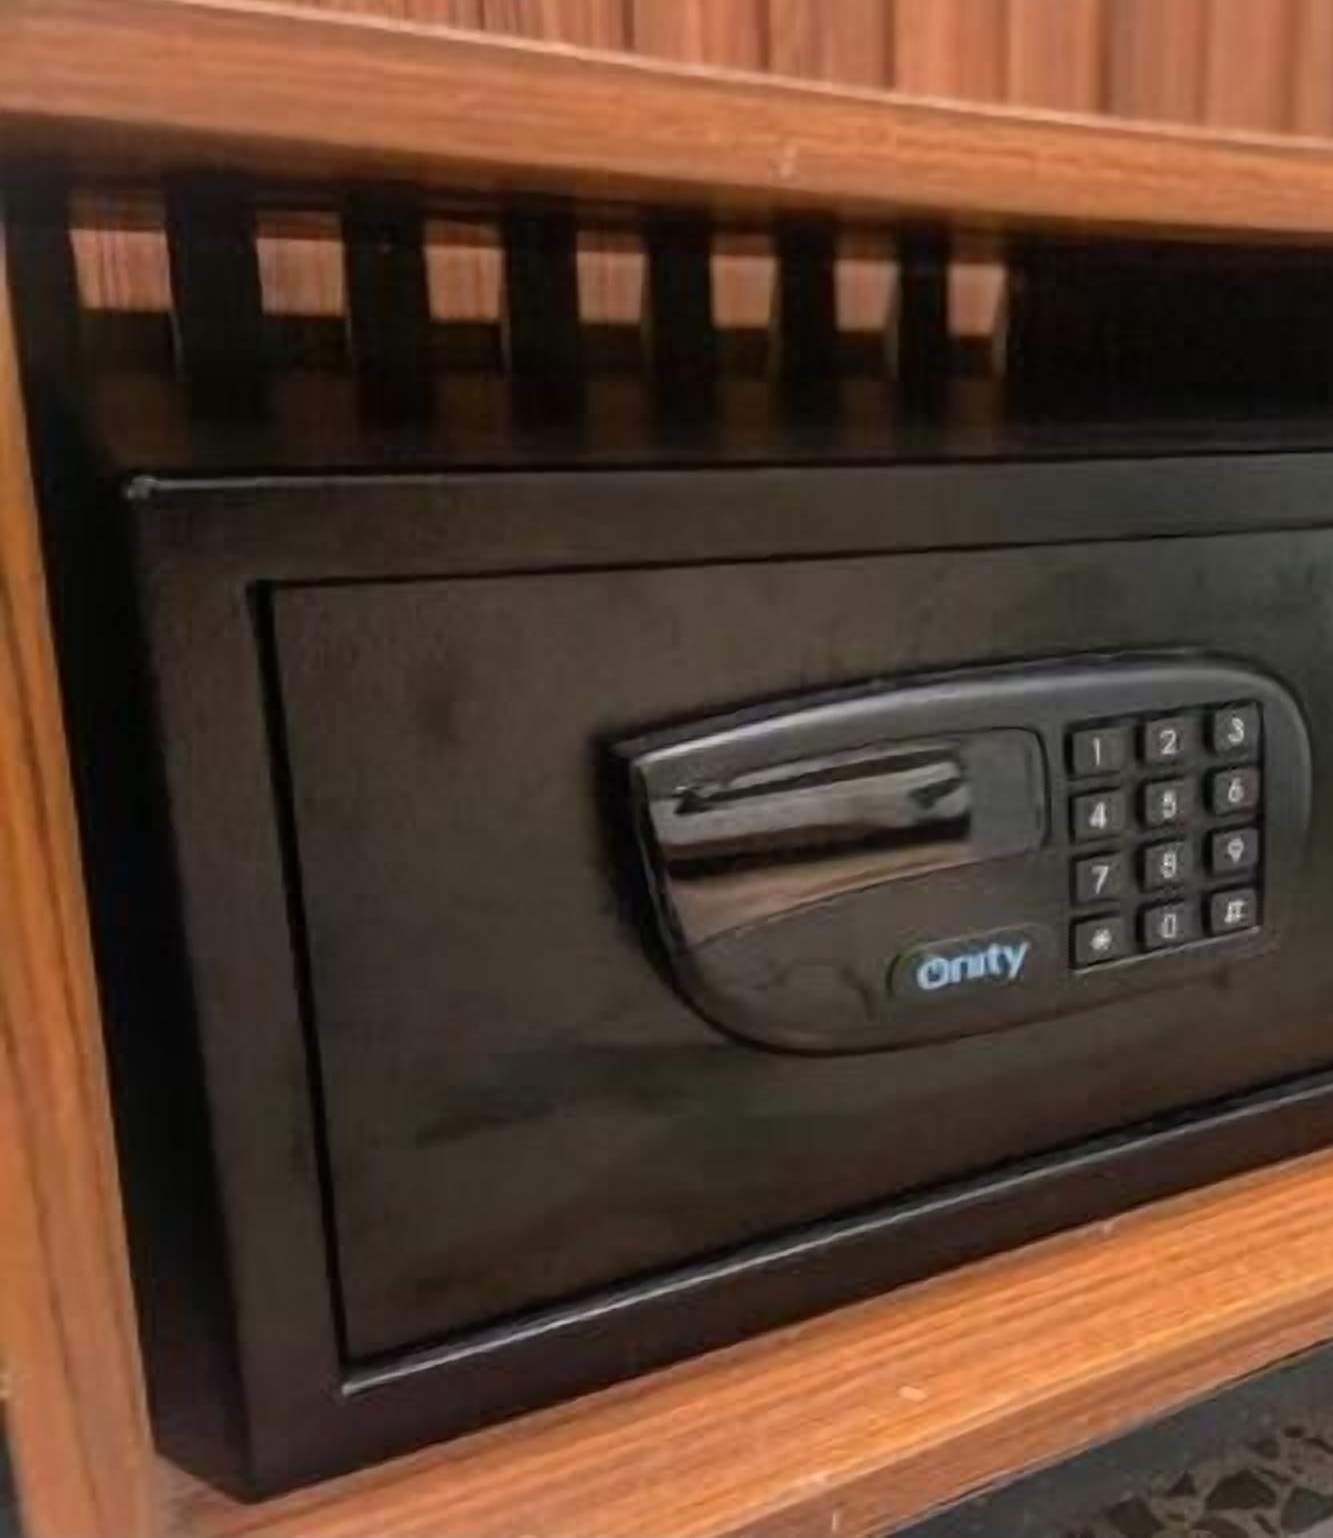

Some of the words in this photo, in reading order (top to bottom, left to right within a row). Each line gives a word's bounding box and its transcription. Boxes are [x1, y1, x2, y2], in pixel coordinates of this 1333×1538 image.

[1159, 728, 1179, 756] 2
[1227, 716, 1245, 745] 3
[1088, 800, 1107, 829] 4
[1161, 789, 1177, 820] 5
[1227, 776, 1244, 803] 6
[1091, 864, 1110, 894] 7
[1160, 850, 1177, 880] 8
[1161, 912, 1176, 939] 0
[1223, 899, 1244, 923] #
[915, 938, 1031, 992] Onity
